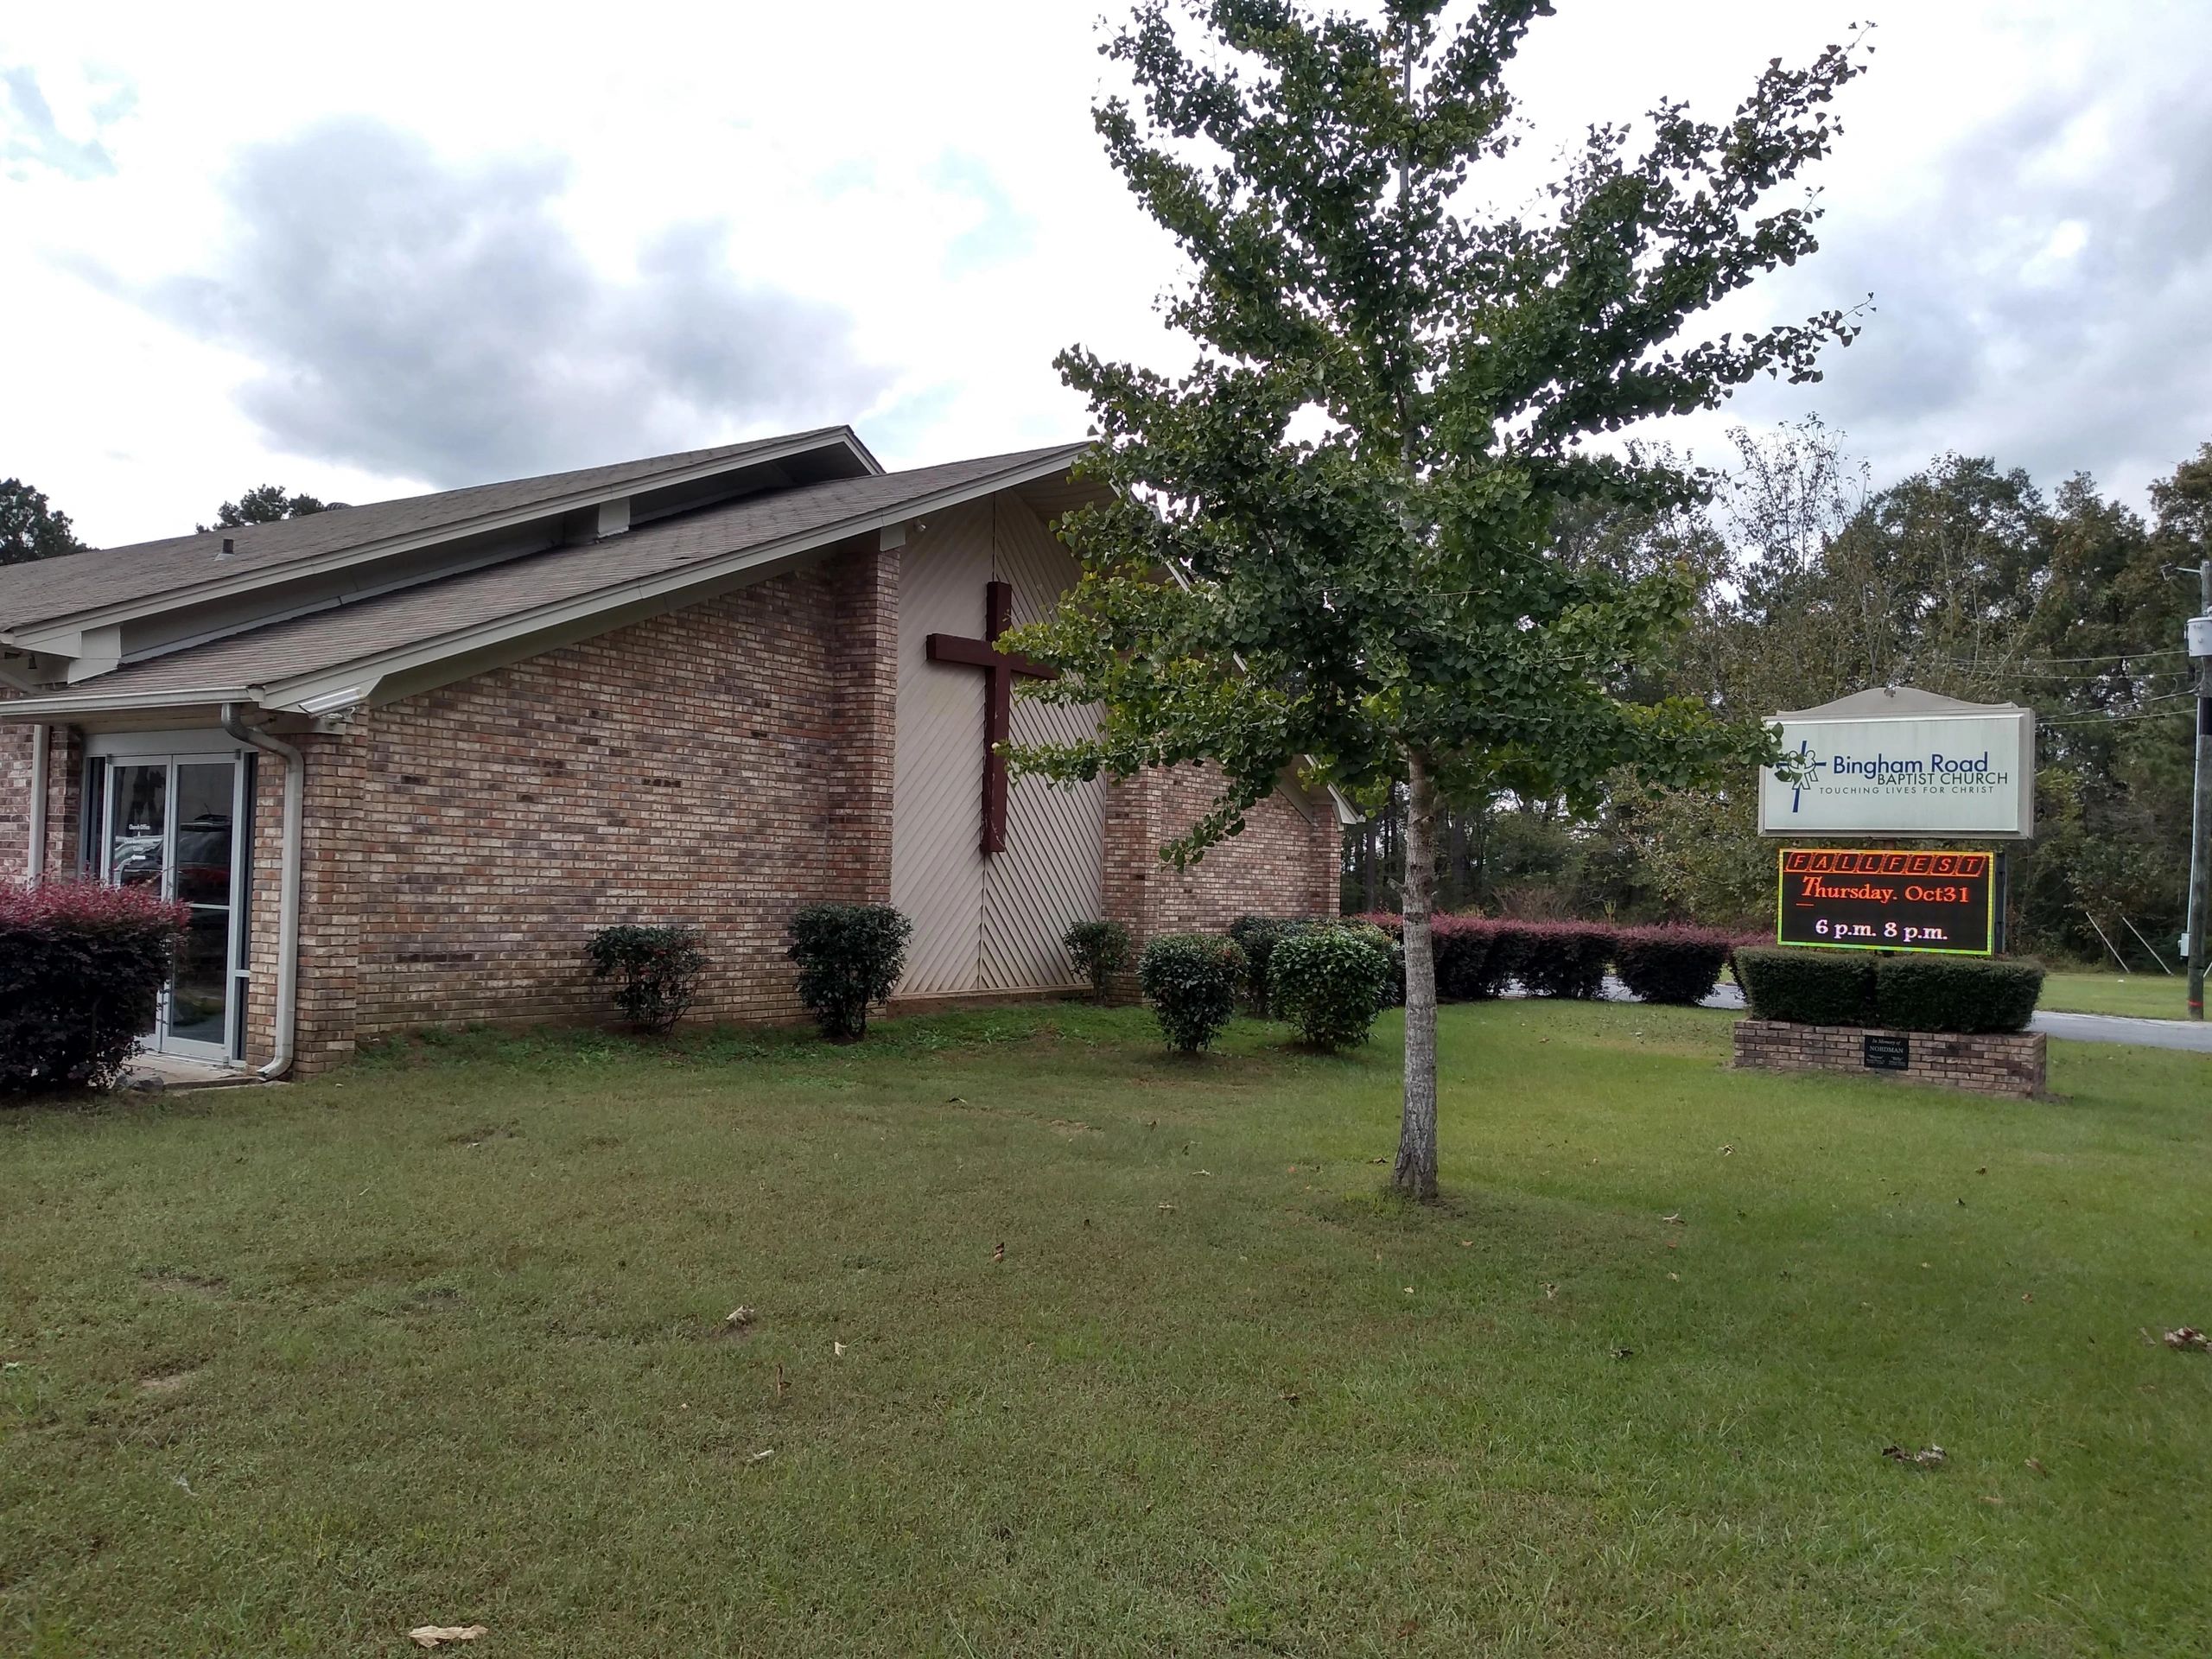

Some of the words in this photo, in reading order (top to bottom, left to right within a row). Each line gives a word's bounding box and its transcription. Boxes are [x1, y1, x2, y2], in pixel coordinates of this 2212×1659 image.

[1834, 753, 1923, 779] Bingham
[1931, 752, 1988, 772] Road
[1878, 773, 1934, 785] BAPTIST
[1940, 772, 2008, 785] CHURCH
[1793, 855, 1978, 872] FALLFEST
[1801, 875, 1897, 904] Thursday.
[1904, 886, 1969, 903] Oct31
[1815, 919, 1828, 934] 6
[1834, 923, 1877, 939] p.m.
[1884, 922, 1897, 938] 8
[1904, 926, 1948, 942] p.m.
